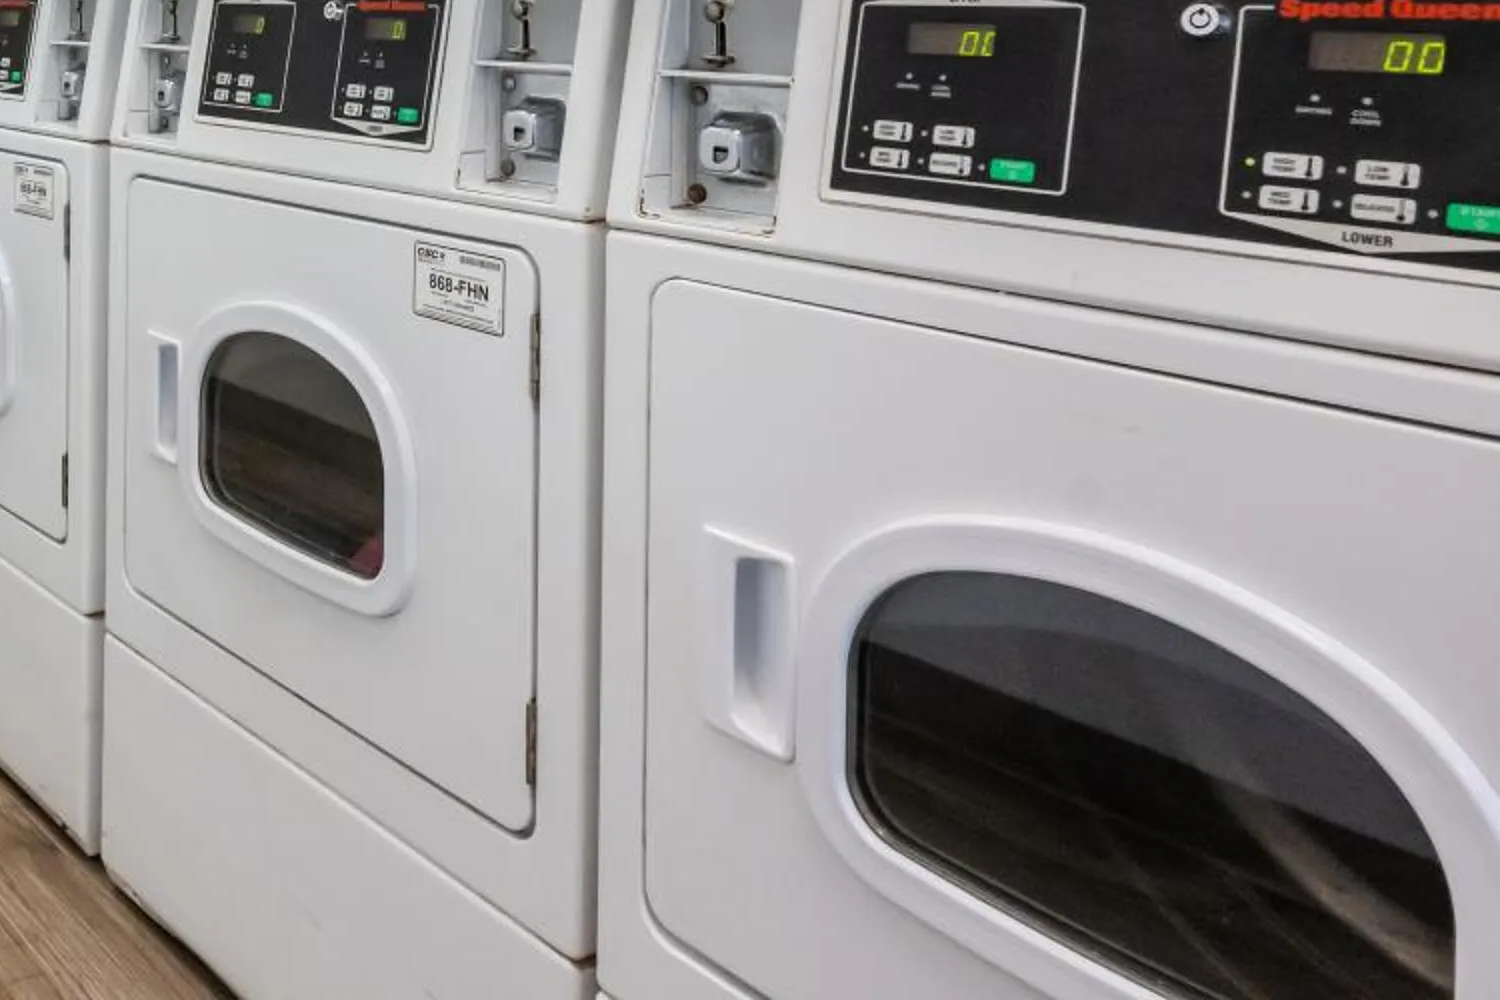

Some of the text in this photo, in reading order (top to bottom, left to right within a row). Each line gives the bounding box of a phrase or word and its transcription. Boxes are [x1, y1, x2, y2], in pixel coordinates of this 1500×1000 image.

[1383, 40, 1446, 74] 00
[1341, 231, 1394, 249] LOWER
[429, 273, 490, 303] 868-FHN
